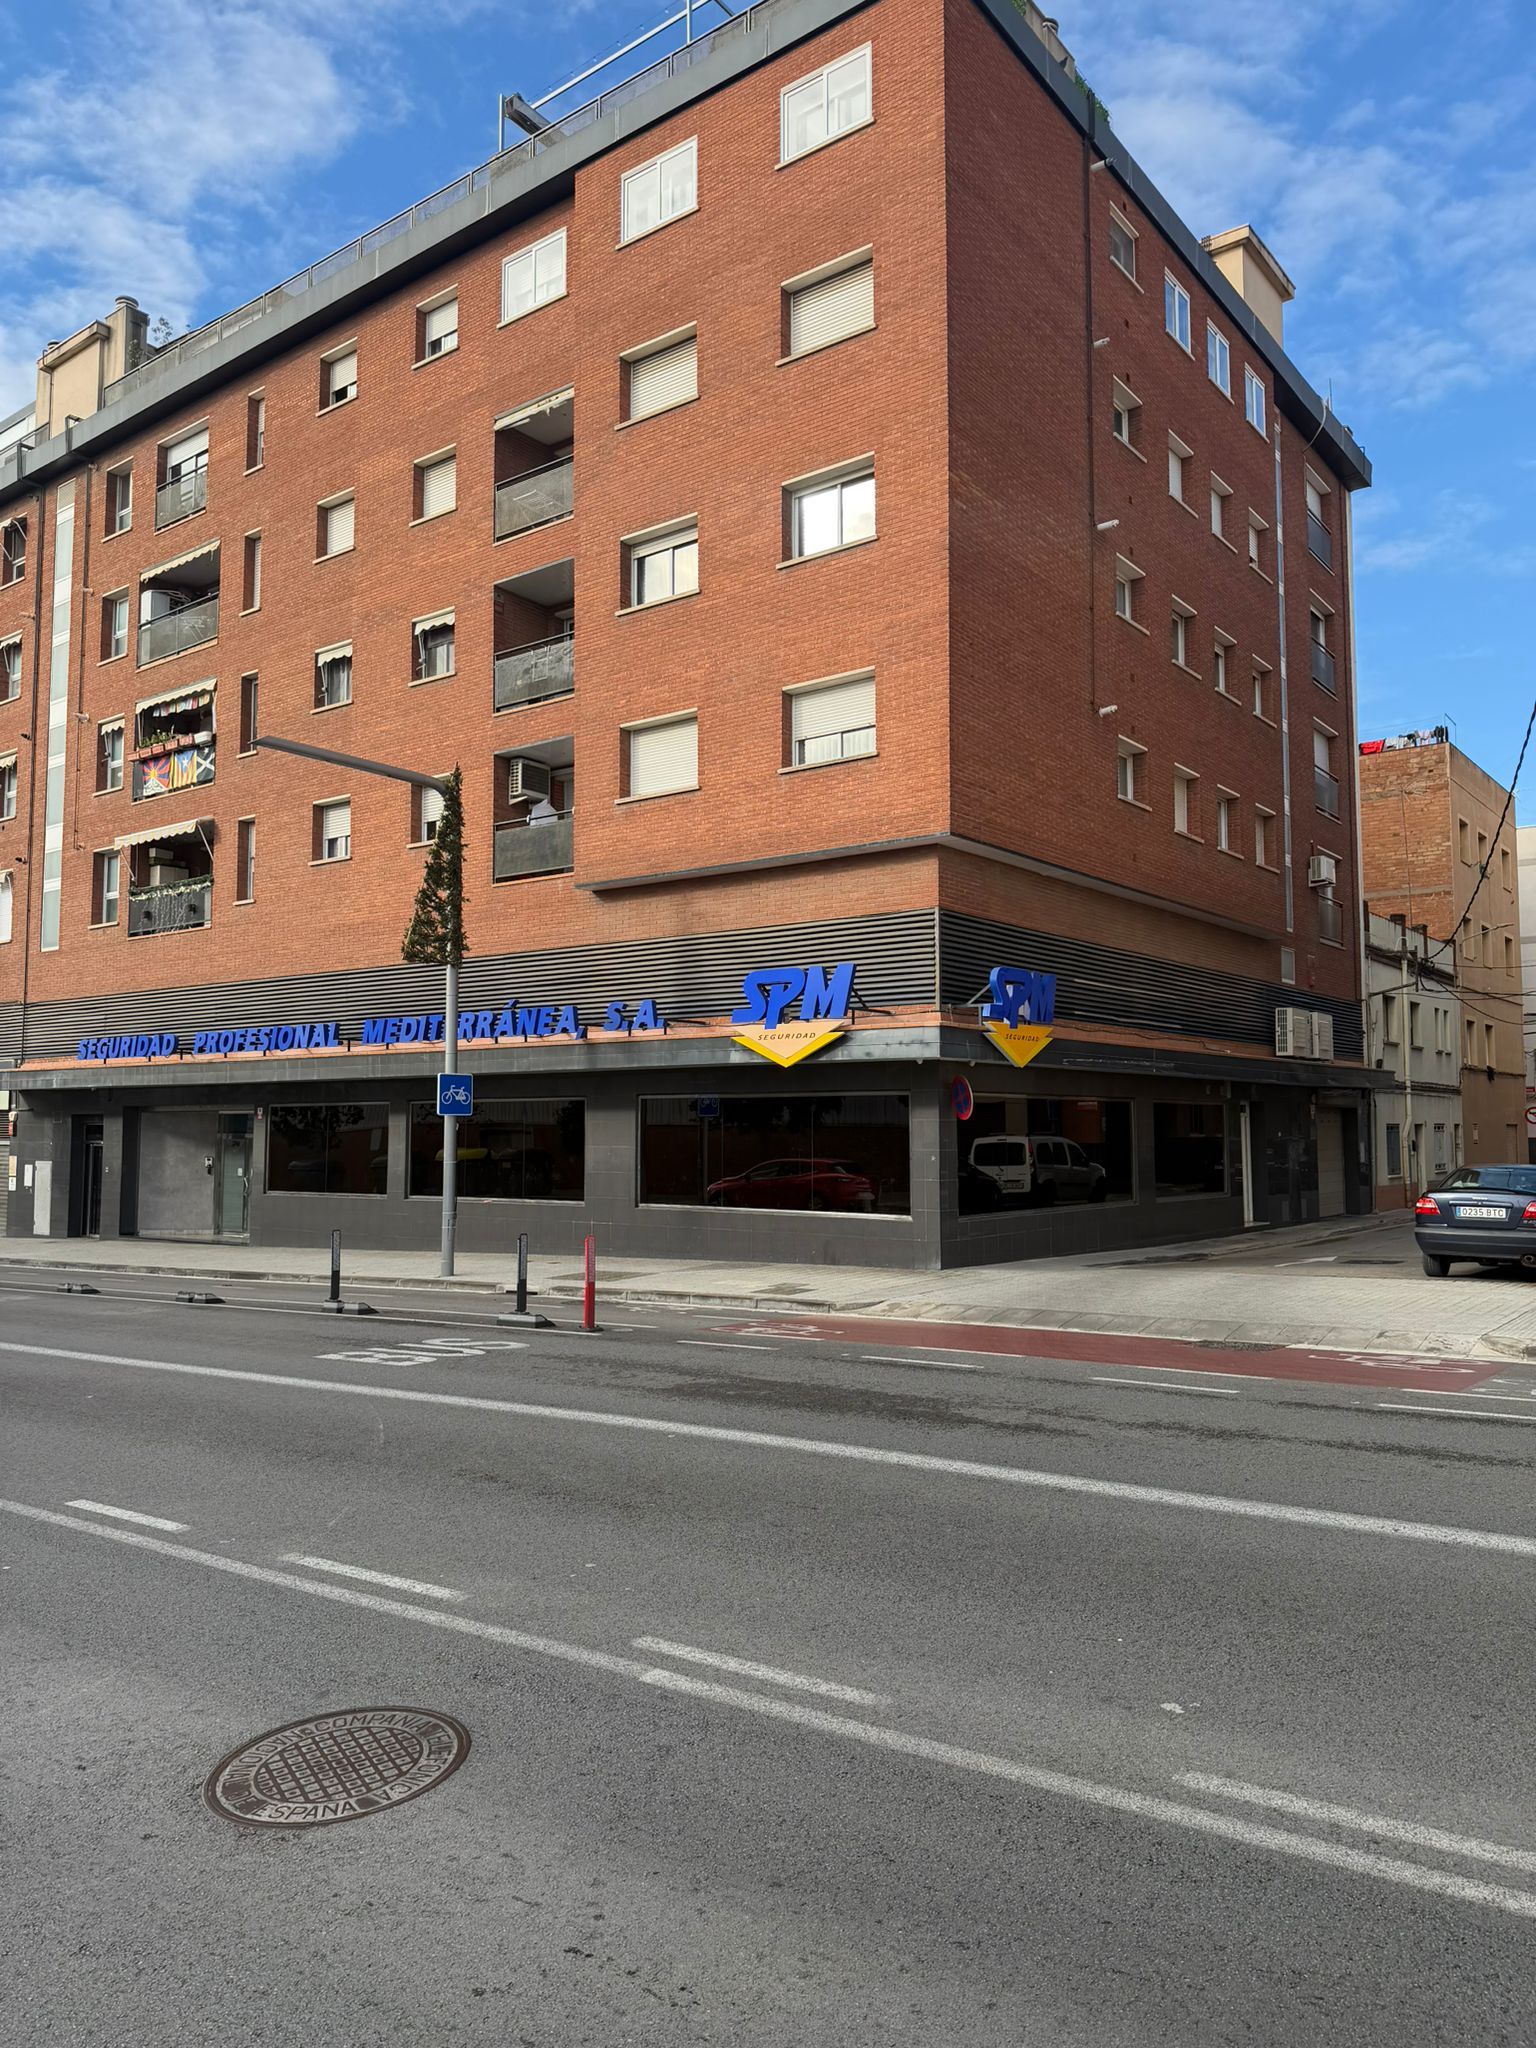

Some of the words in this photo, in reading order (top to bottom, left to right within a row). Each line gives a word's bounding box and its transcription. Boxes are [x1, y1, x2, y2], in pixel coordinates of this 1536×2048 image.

[731, 963, 856, 1029] SPM
[983, 966, 1056, 1029] SPM
[77, 1034, 178, 1060] SEGURIDAD
[193, 1022, 341, 1055] PROFESIONAL
[361, 999, 587, 1044] MEDITRRÁNEA,
[603, 999, 665, 1032] S.A.
[757, 1032, 816, 1041] SEGURIDAD
[1005, 1033, 1039, 1042] SEGURIDAD
[1462, 1208, 1484, 1216] 0235
[1486, 1209, 1504, 1217] BTC
[313, 1338, 530, 1366] BUS
